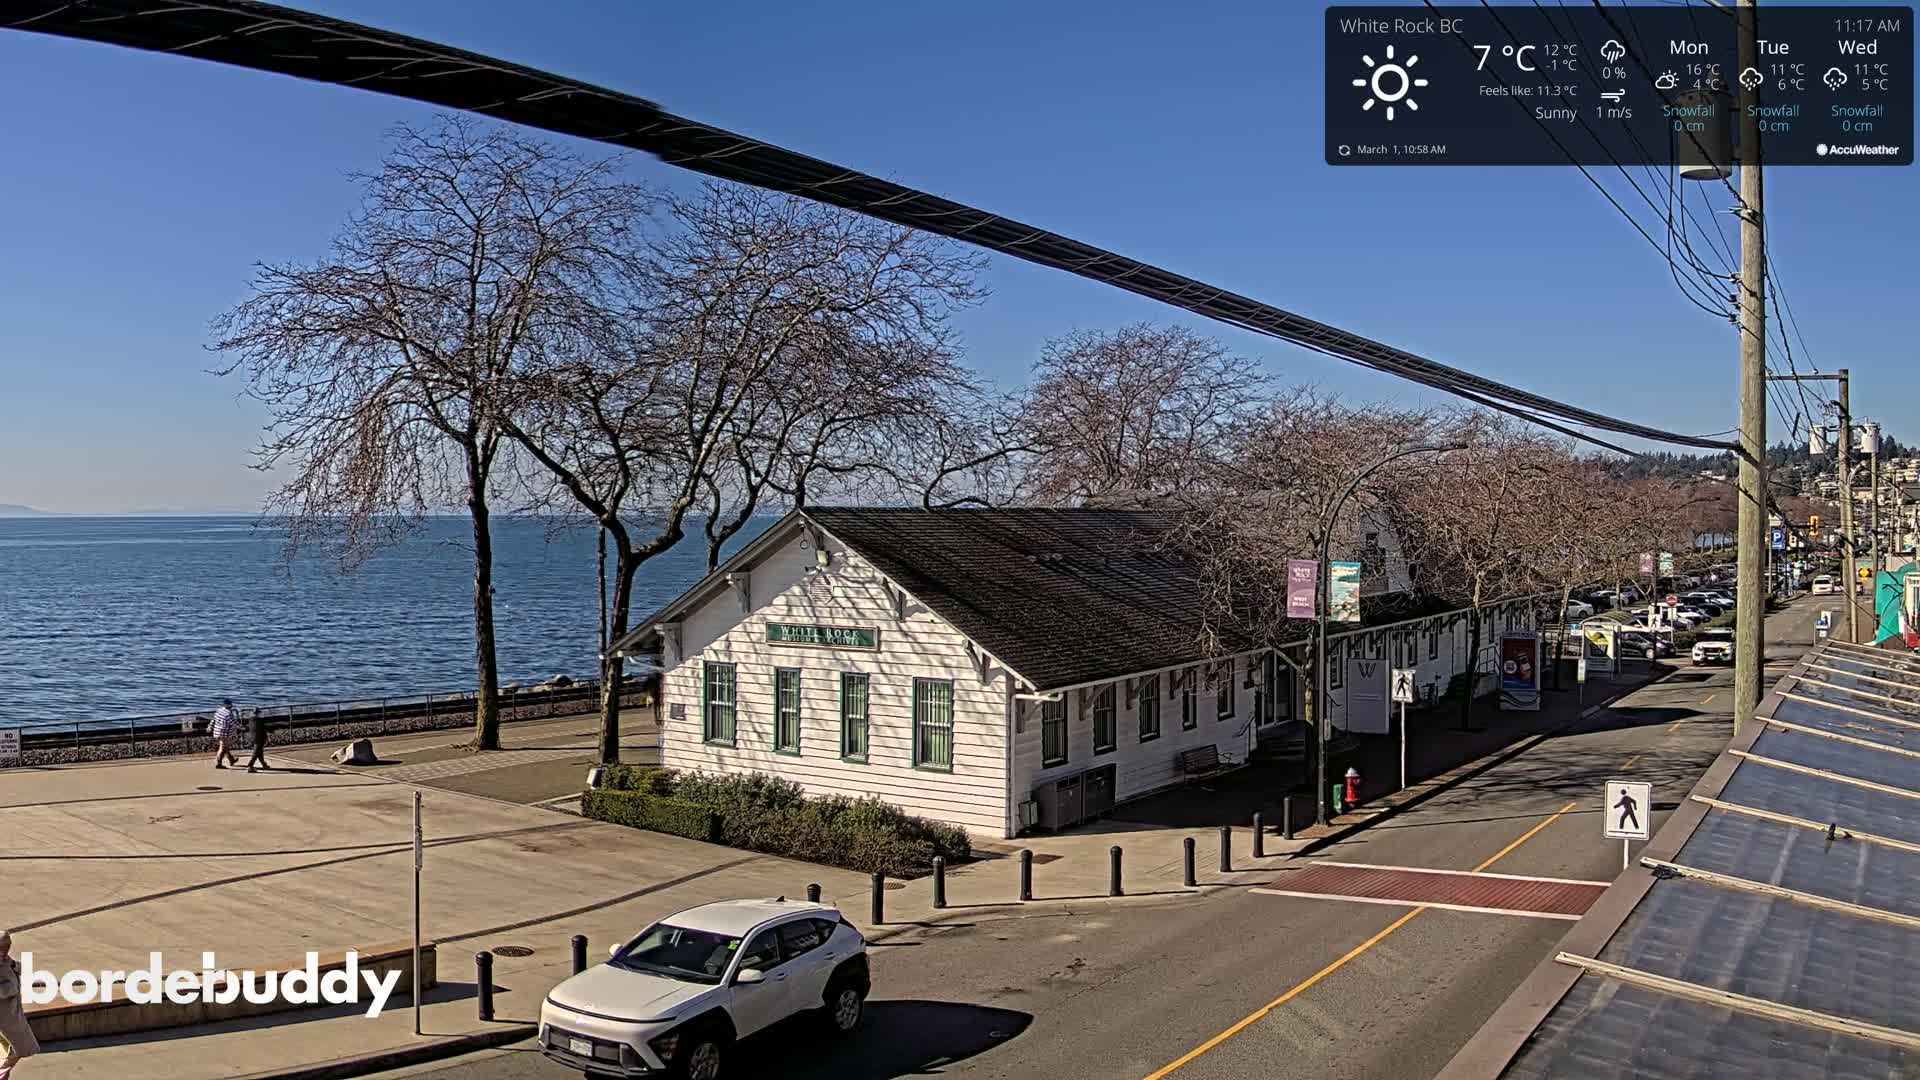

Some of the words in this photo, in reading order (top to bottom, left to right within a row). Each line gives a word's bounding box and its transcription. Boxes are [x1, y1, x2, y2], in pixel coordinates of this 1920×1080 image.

[1773, 532, 1781, 541] P
[780, 626, 819, 637] WHITE
[825, 628, 859, 639] ROCK
